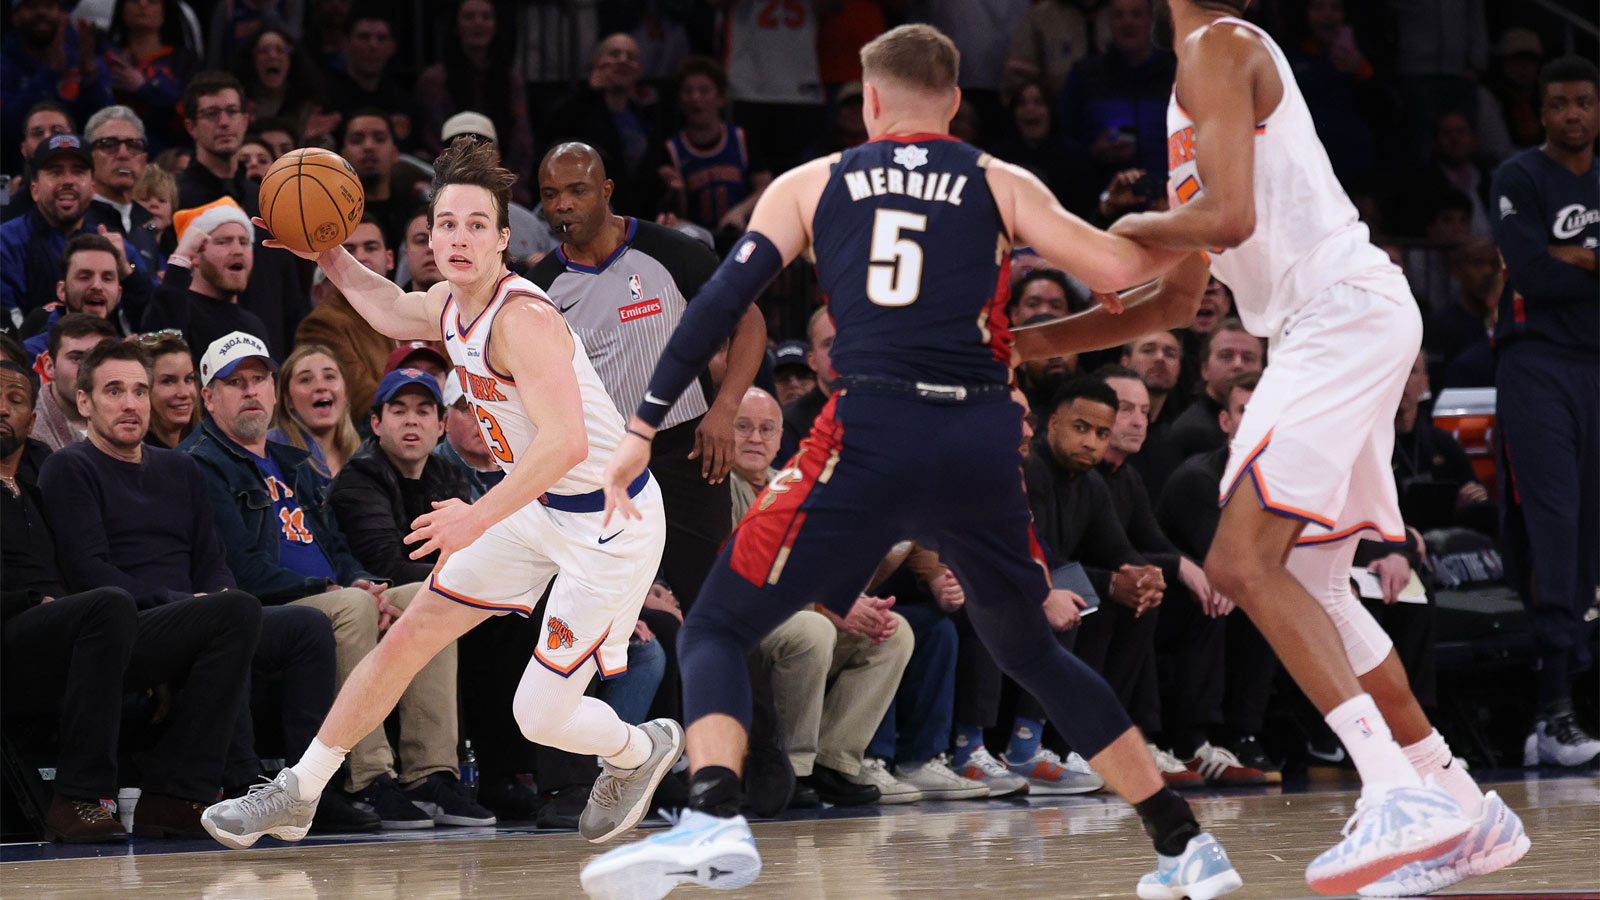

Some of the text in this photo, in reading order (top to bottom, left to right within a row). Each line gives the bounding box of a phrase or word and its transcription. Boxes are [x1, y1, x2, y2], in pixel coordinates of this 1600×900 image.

[844, 167, 968, 206] MERRILL
[866, 208, 927, 307] 5
[620, 302, 660, 319] Emirates
[219, 337, 241, 355] YORK
[547, 616, 573, 648] KNICKS
